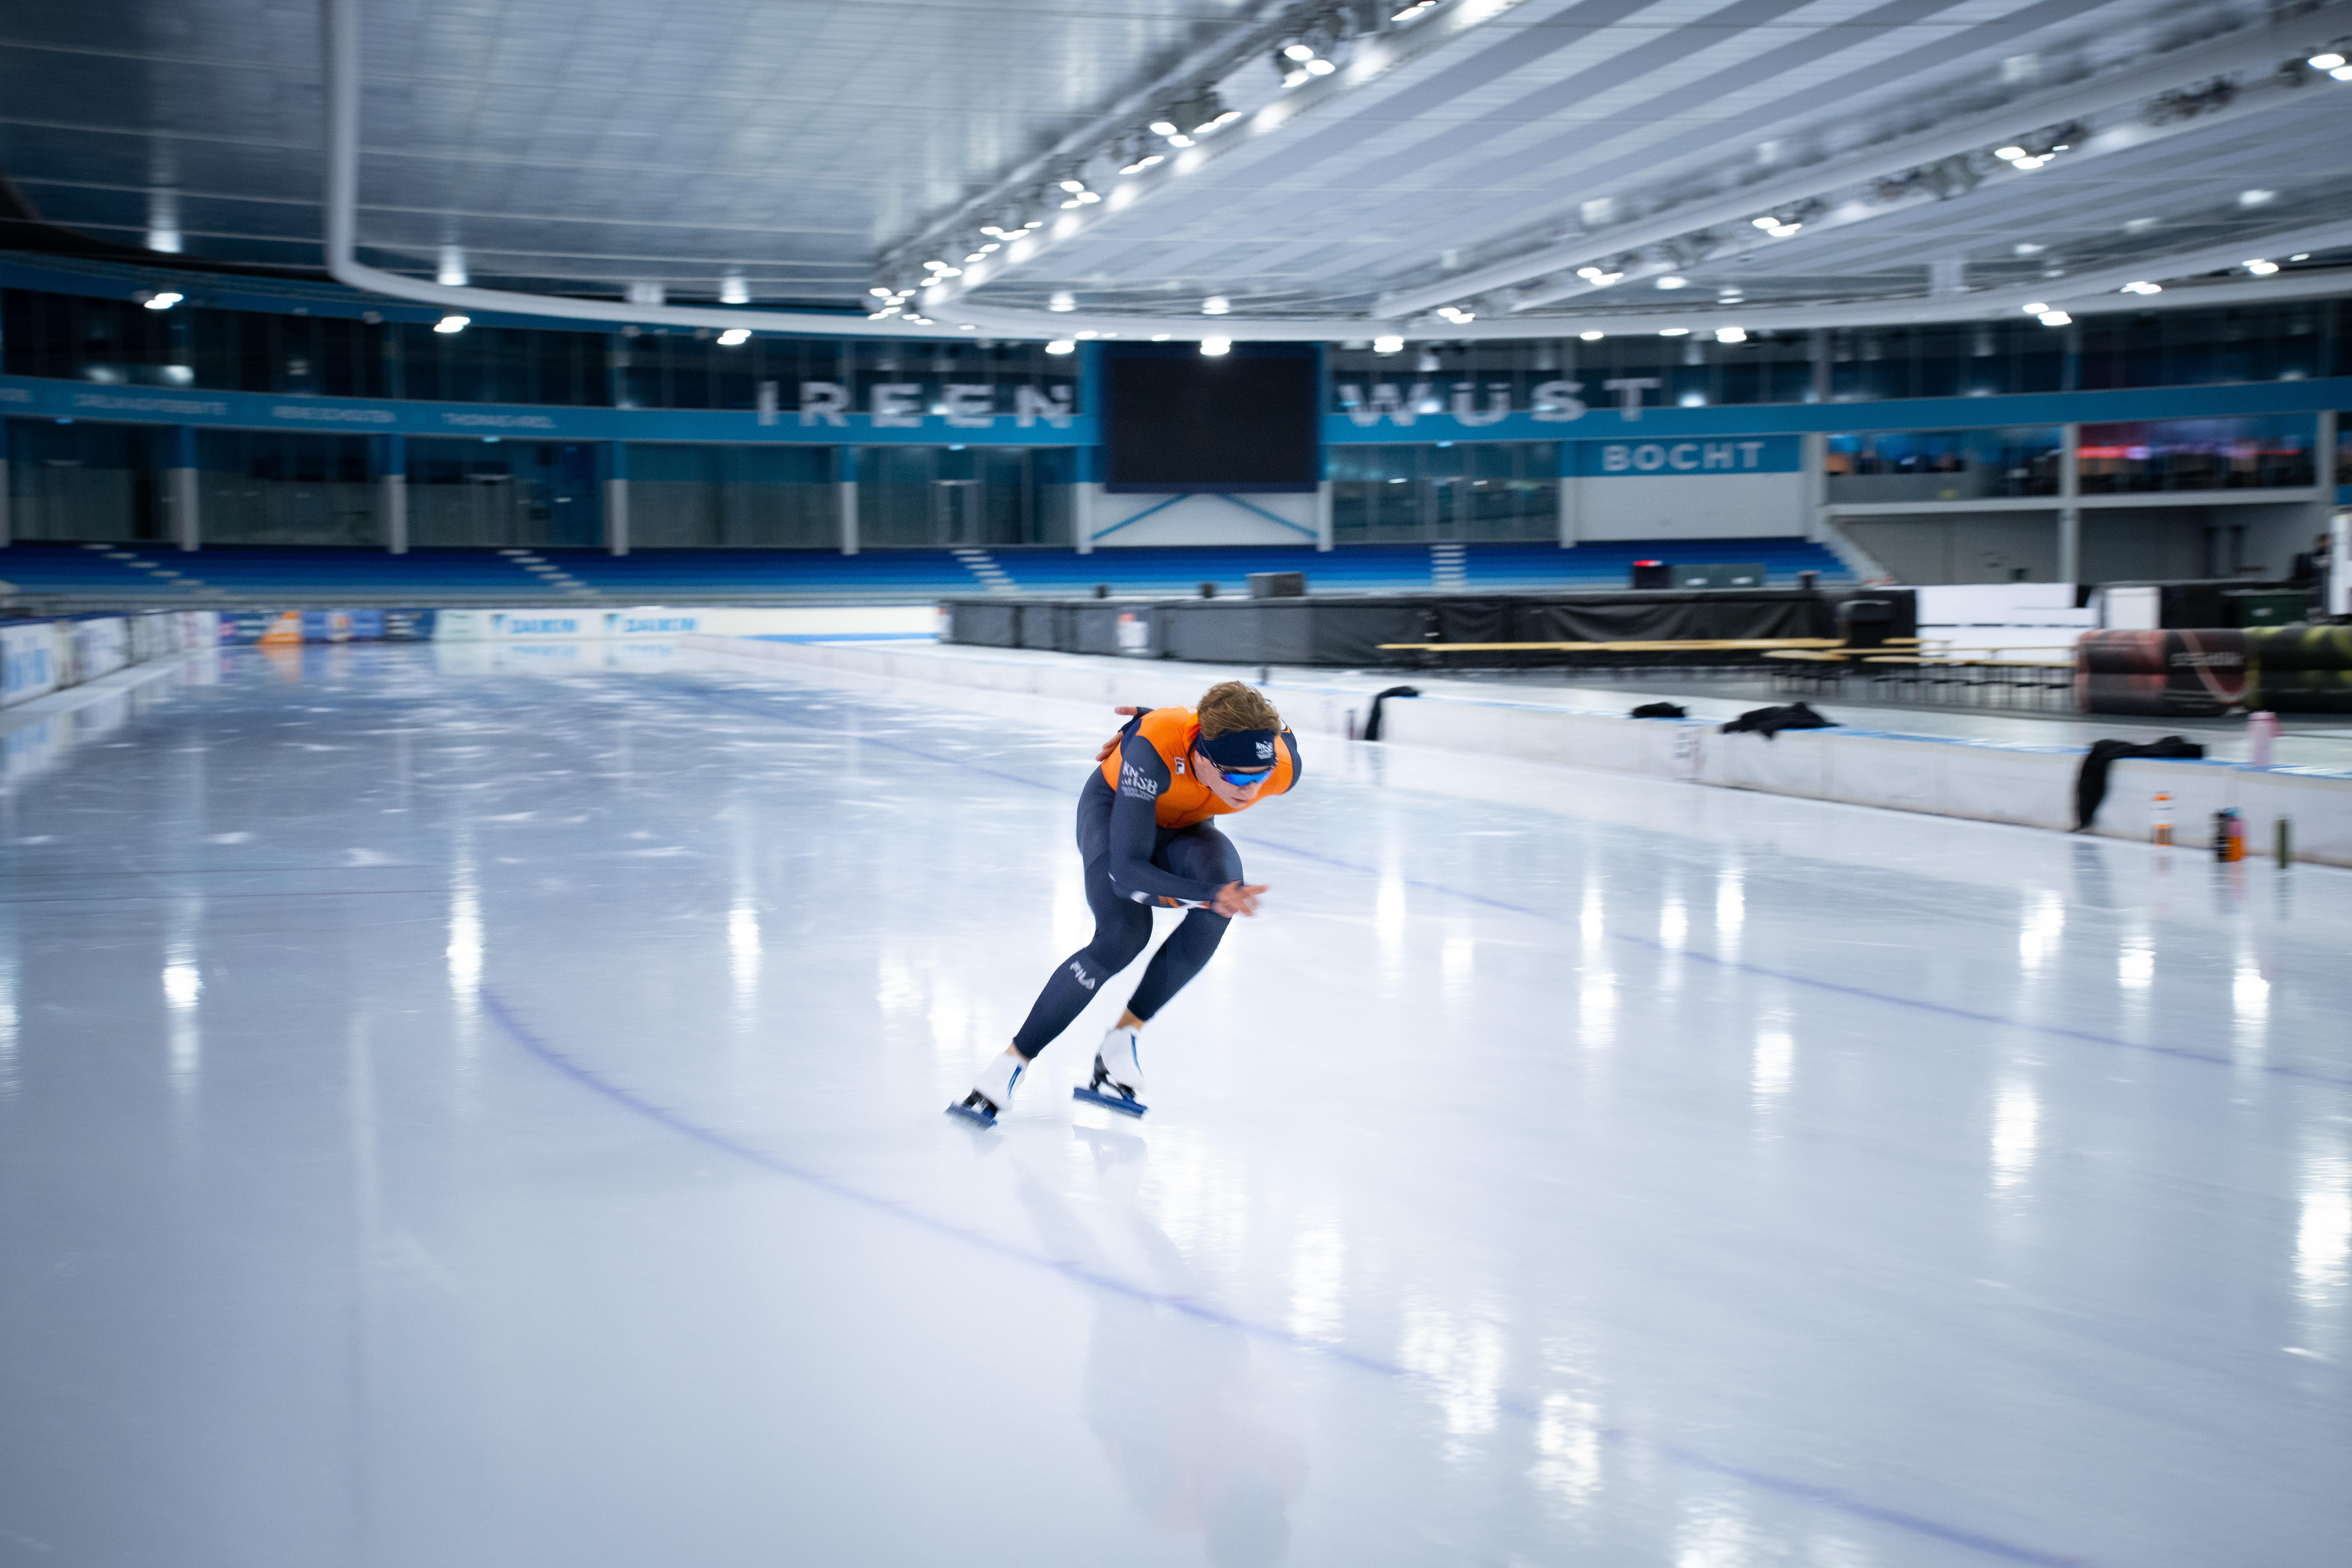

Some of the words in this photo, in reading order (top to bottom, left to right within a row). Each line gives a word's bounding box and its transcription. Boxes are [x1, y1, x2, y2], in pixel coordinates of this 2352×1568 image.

[757, 381, 1073, 428] IREEN
[1602, 442, 1764, 471] BOCHT
[1069, 960, 1096, 990] FILA
